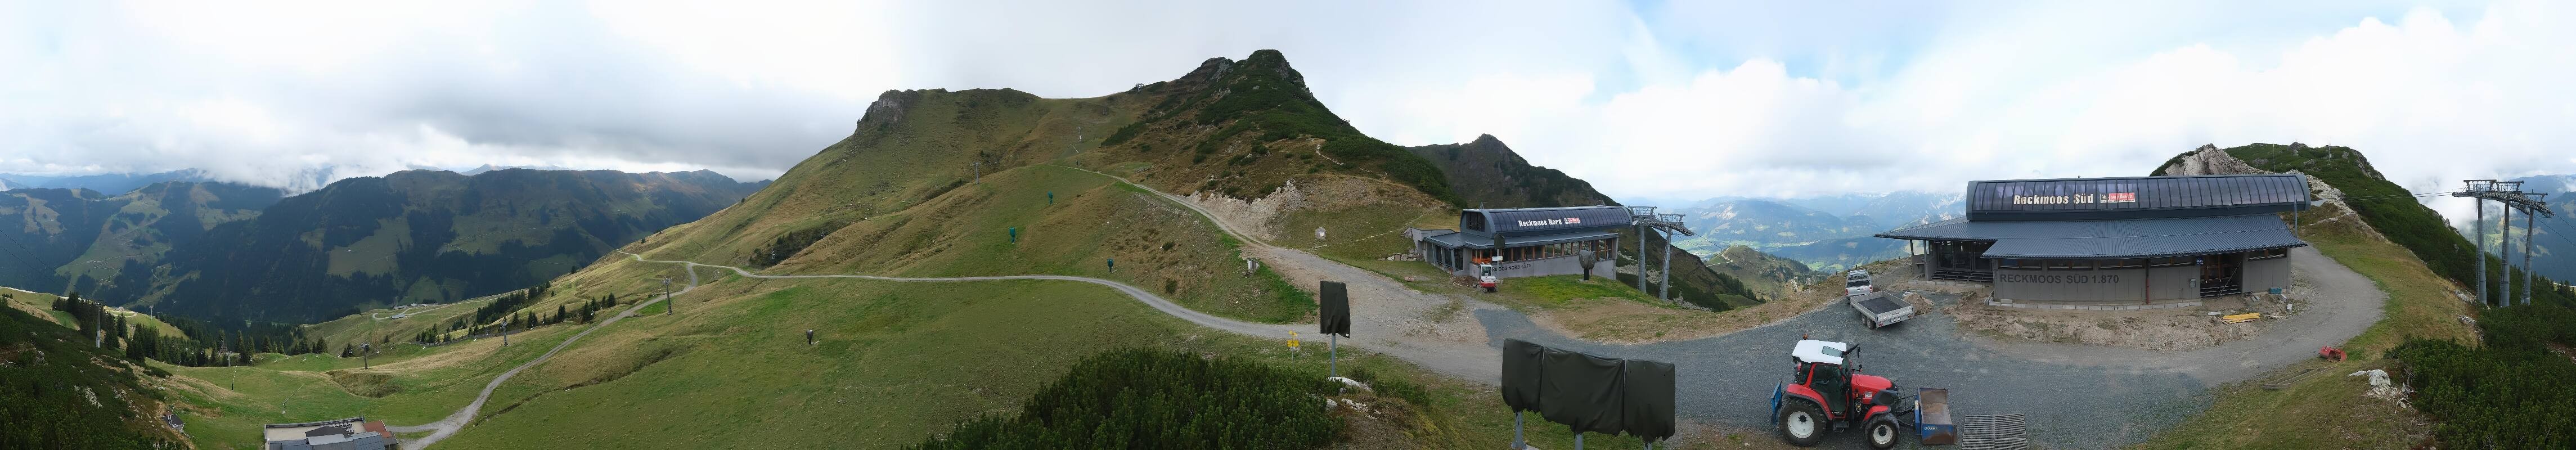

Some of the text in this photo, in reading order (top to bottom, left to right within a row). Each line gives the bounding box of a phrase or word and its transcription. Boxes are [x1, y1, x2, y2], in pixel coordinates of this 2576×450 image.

[2013, 194, 2093, 205] Reckmoos Süd
[2000, 273, 2119, 284] RECKMOOS SÜD 1.870
